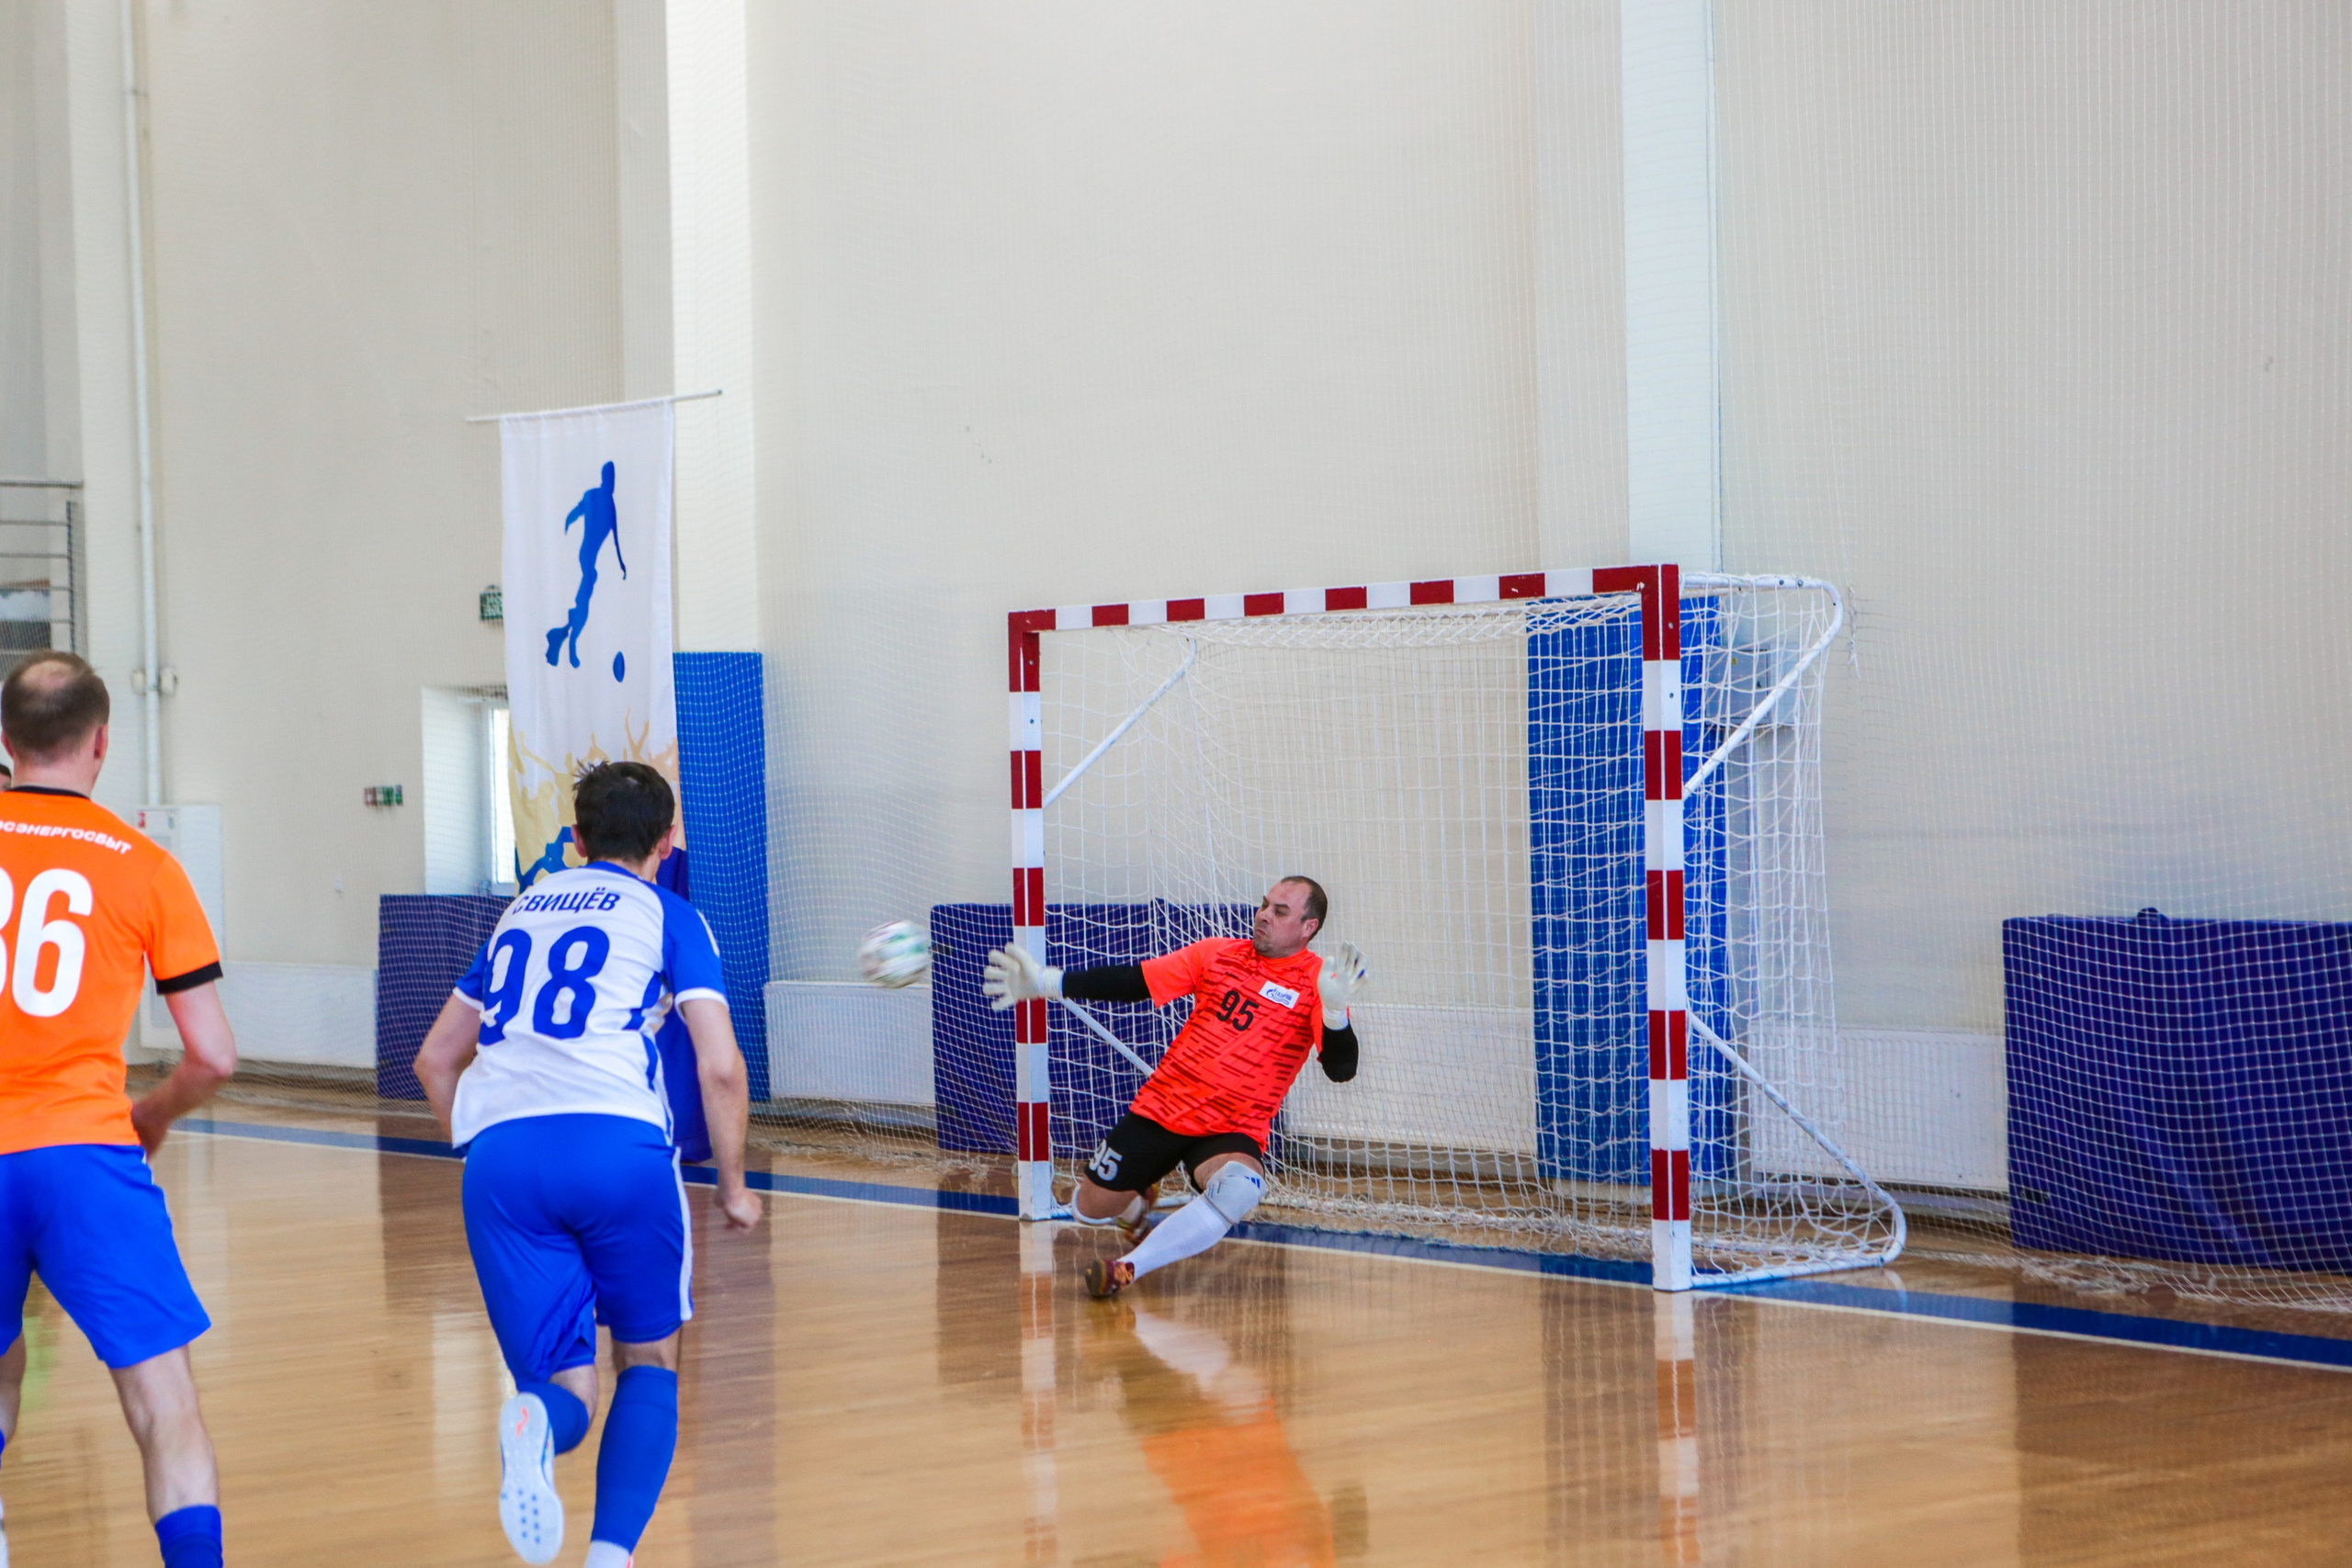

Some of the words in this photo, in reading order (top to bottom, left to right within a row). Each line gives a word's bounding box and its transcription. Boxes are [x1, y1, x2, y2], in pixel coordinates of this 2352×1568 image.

[0, 820, 131, 854] СЭНЕРГОСБЫТ
[513, 886, 620, 915] СВИЩЁВ
[0, 867, 93, 1018] 6
[479, 926, 609, 1046] 98
[1216, 990, 1260, 1032] 95
